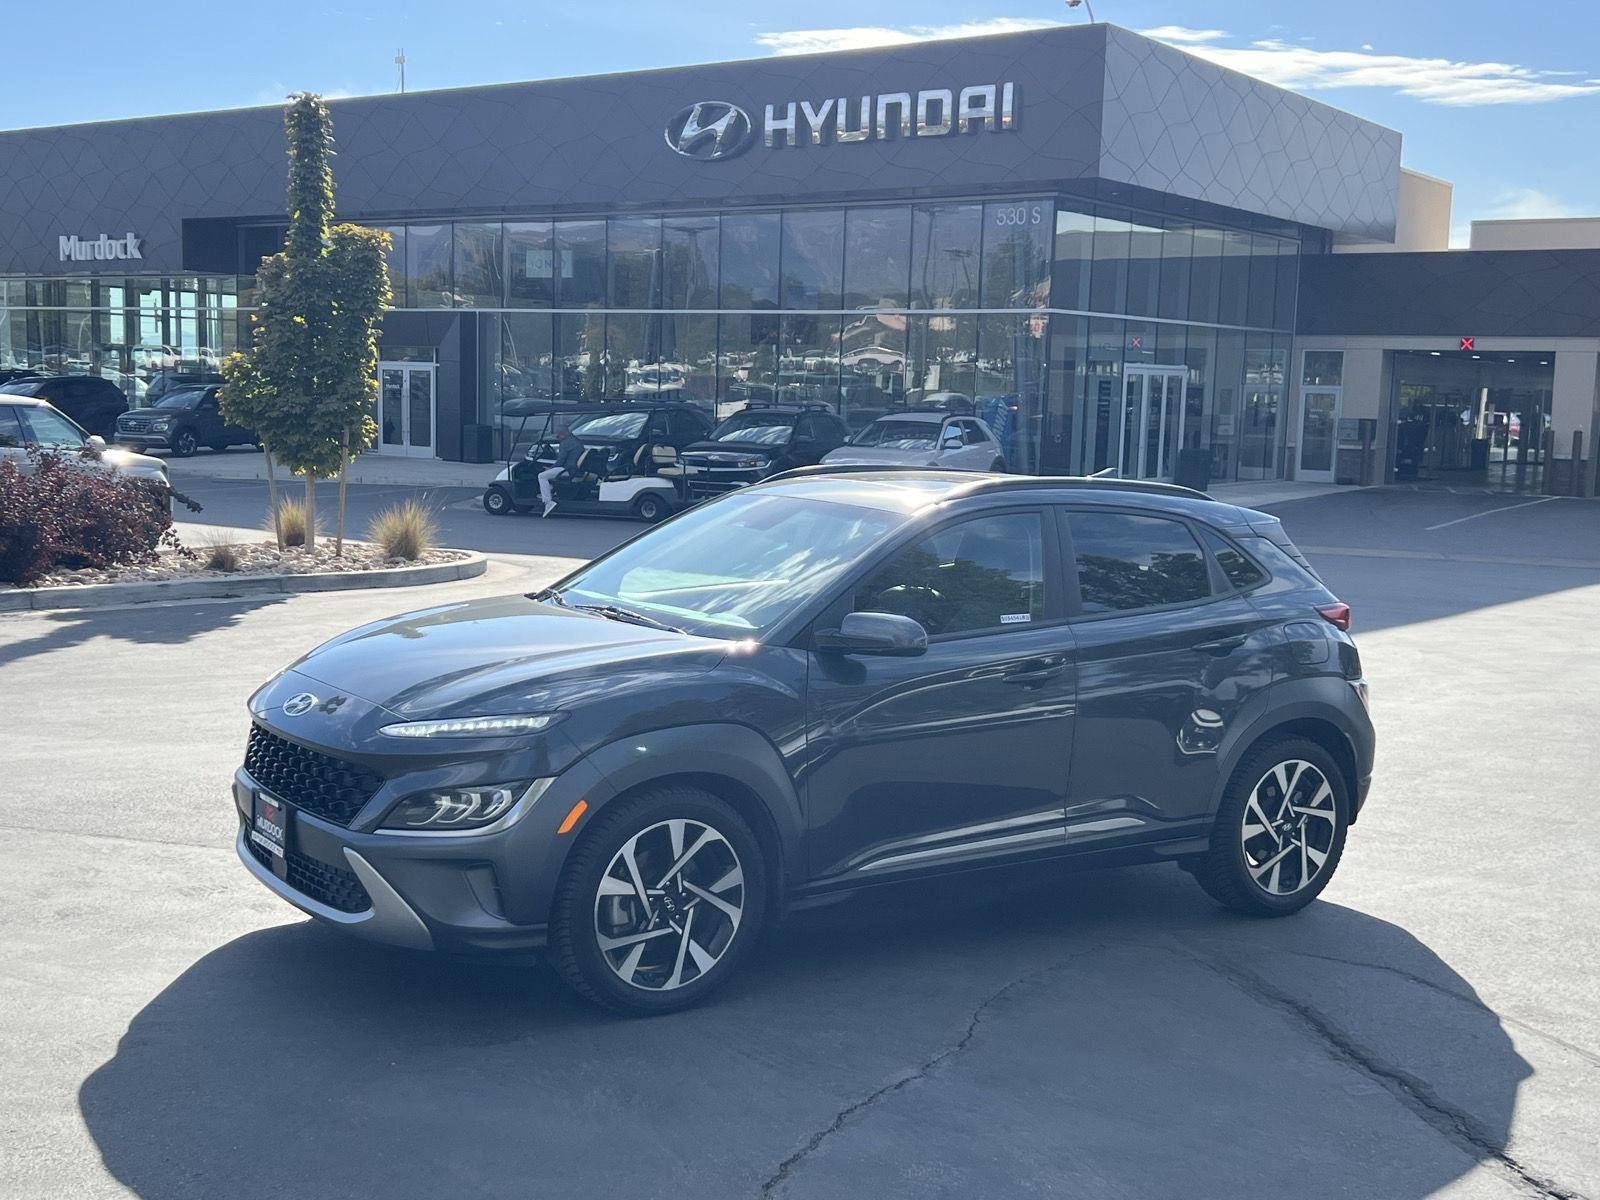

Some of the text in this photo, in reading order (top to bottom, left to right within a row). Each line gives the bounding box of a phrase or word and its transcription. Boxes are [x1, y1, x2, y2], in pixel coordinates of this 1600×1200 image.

[763, 81, 1015, 148] HYUNDAI
[996, 206, 1041, 226] 530 S
[58, 231, 143, 262] Murdock
